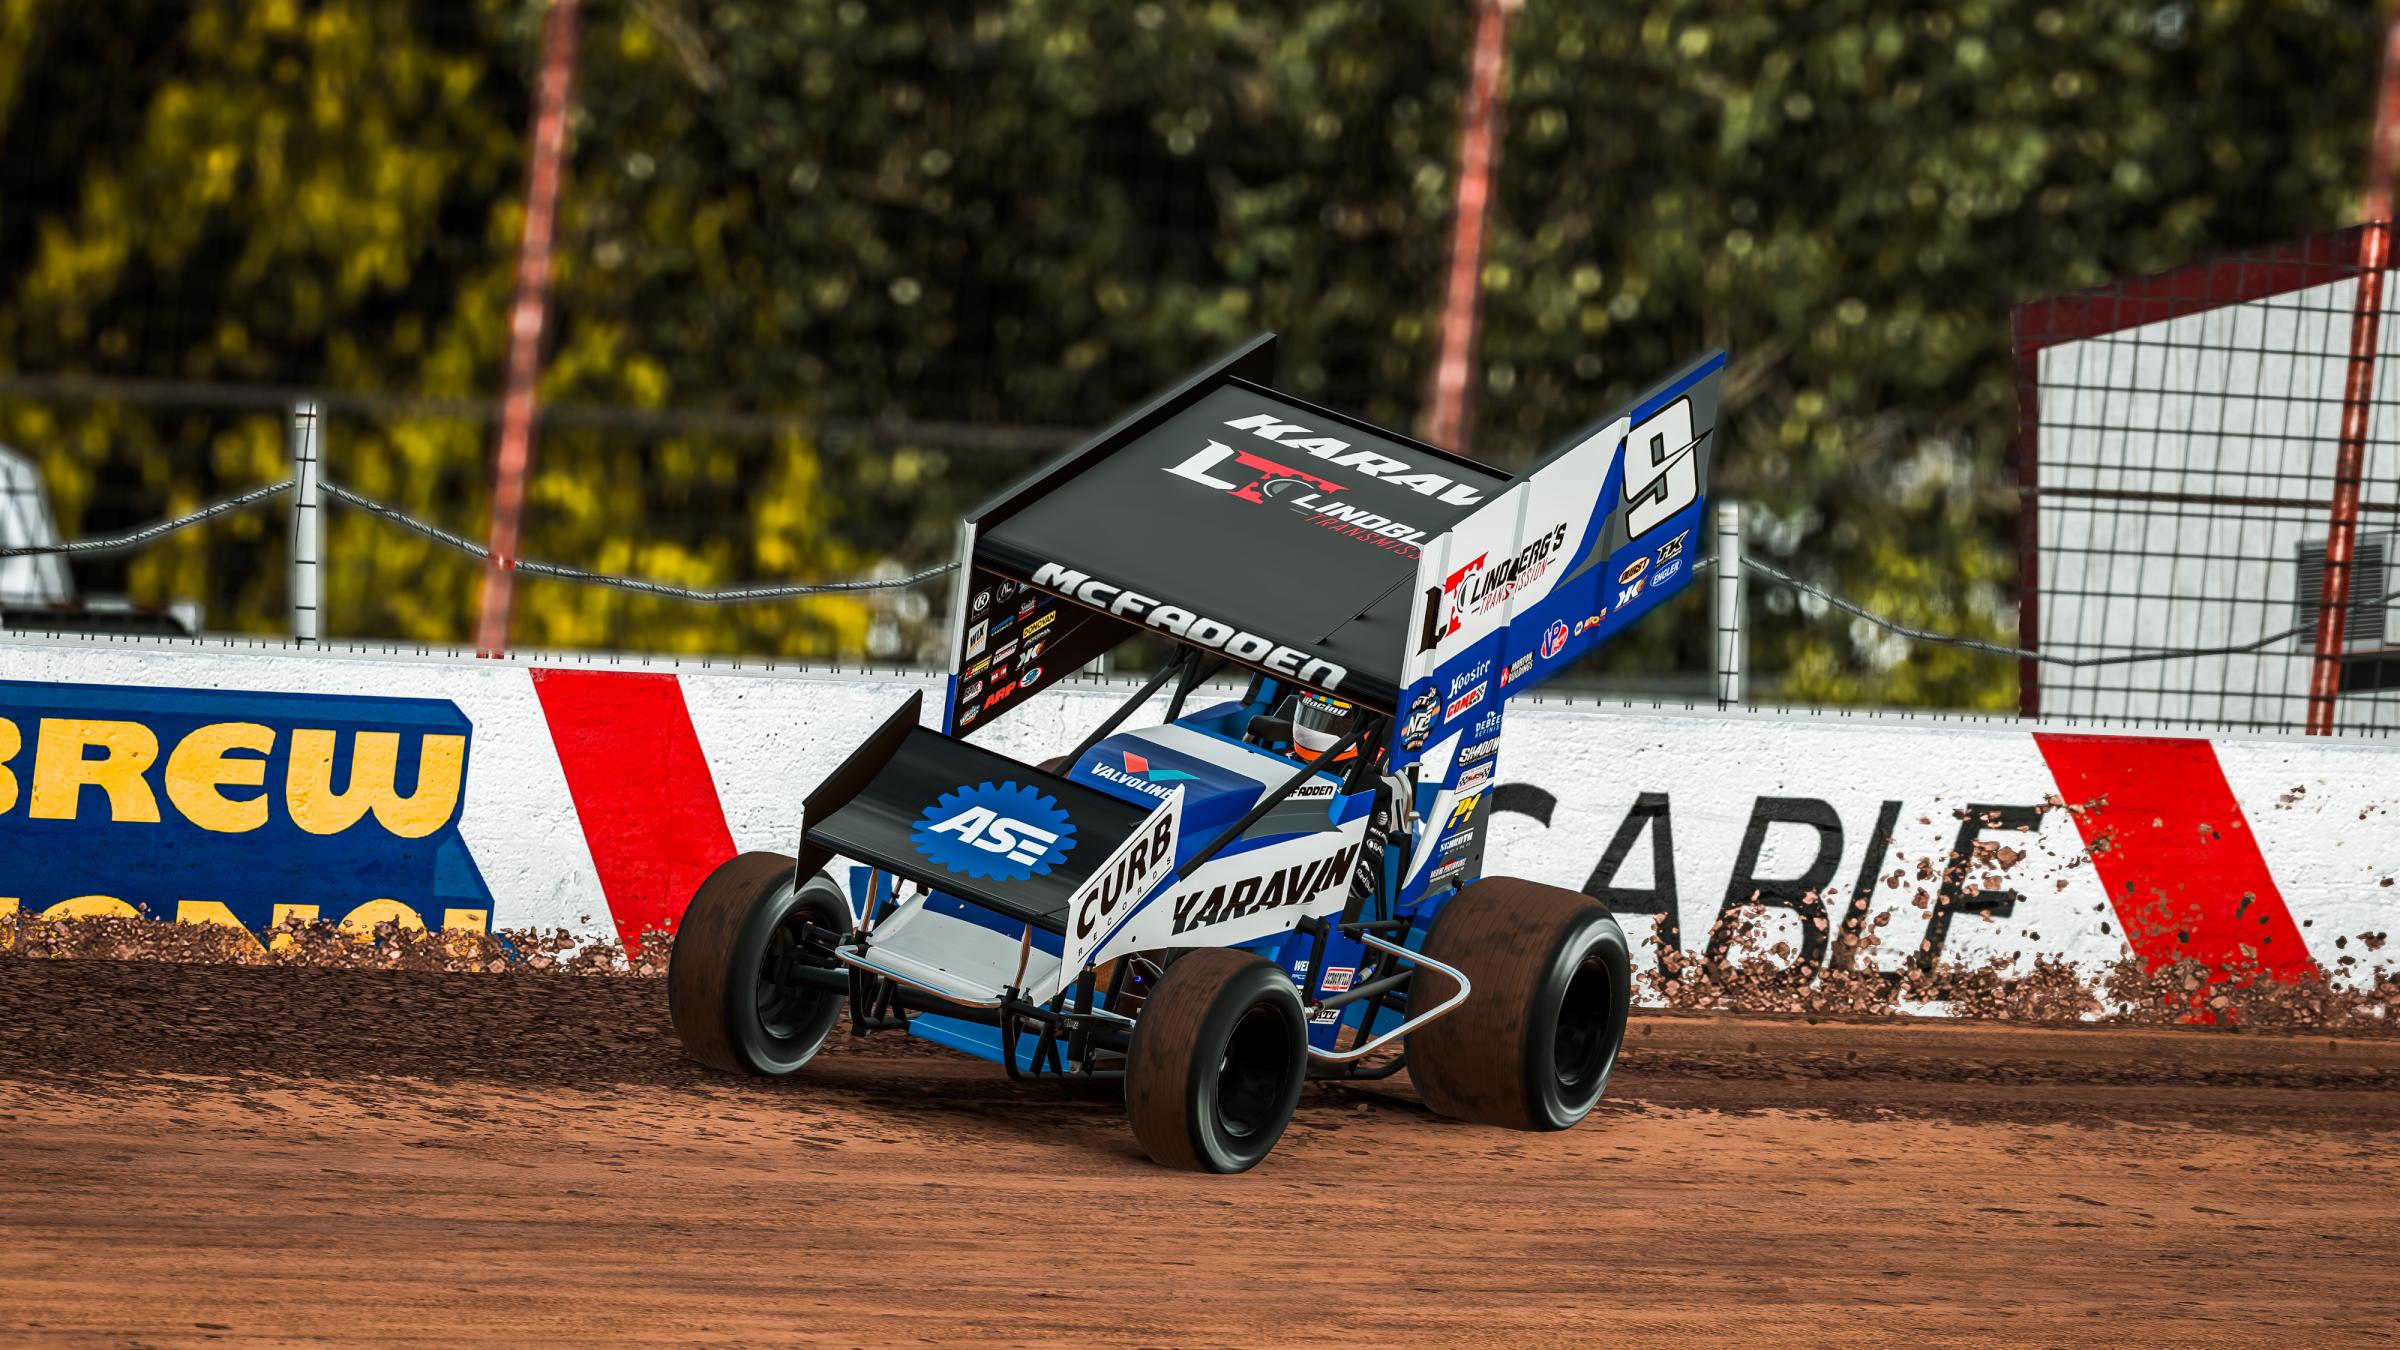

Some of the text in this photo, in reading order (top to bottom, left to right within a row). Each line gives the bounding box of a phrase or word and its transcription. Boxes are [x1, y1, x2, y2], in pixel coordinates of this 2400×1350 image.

[1622, 394, 1713, 542] 9
[1480, 557, 1549, 615] TRANSISSION
[1653, 560, 1680, 585] ENGLER
[1024, 612, 1055, 637] DONOVAN
[1031, 562, 1347, 692] MCFADDEN
[983, 681, 1016, 711] ARP
[1447, 690, 1477, 718] COMP
[0, 717, 466, 838] REW
[1090, 762, 1174, 801] VALVOLINE
[1288, 785, 1334, 797] FADDEN
[927, 805, 1060, 867] ASE
[1077, 813, 1173, 940] CURB
[1490, 783, 2046, 1000] ABLE
